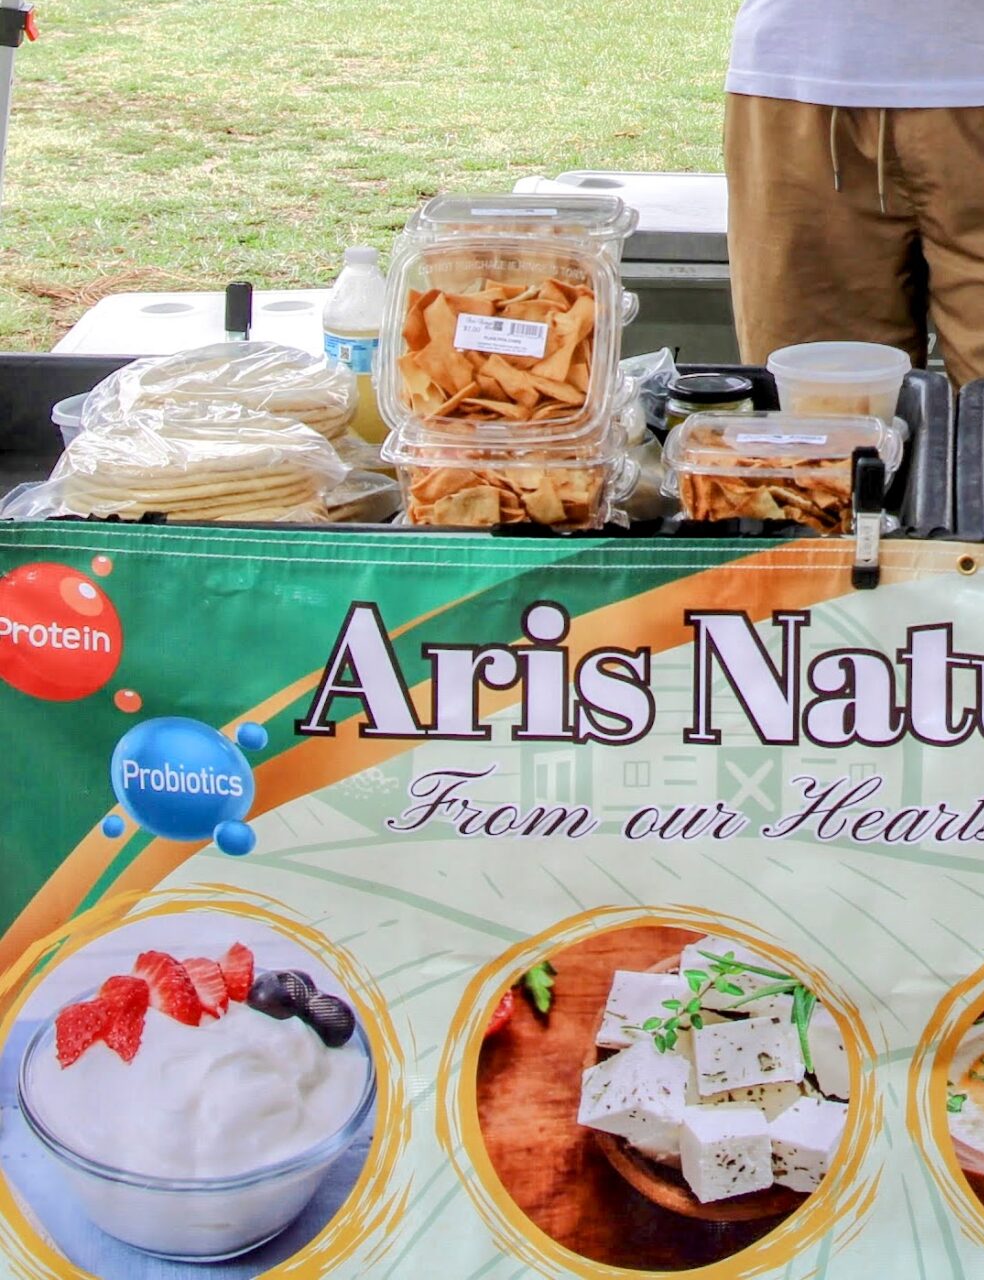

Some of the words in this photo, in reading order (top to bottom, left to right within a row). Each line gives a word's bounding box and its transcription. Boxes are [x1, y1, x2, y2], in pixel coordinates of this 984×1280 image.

[294, 600, 656, 746] Aris
[121, 758, 243, 798] Probiotics
[387, 764, 597, 840] From
[623, 800, 748, 841] our
